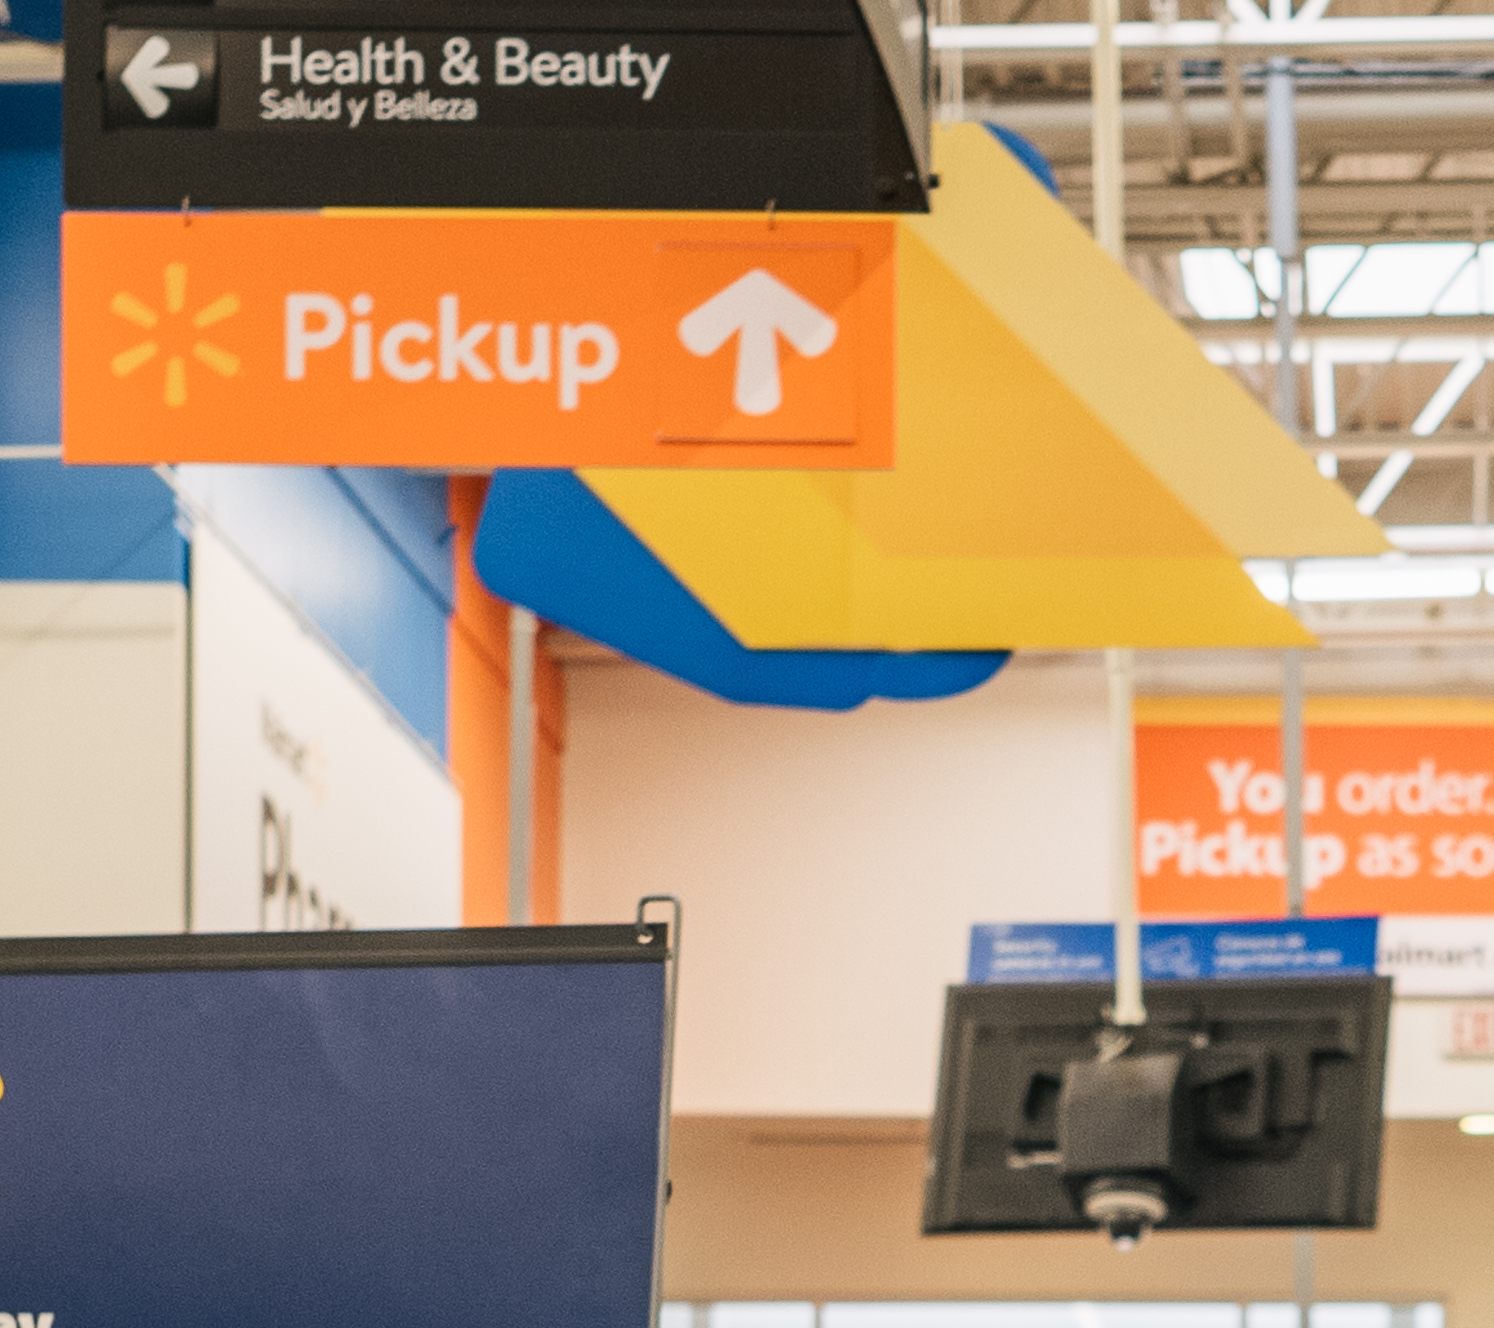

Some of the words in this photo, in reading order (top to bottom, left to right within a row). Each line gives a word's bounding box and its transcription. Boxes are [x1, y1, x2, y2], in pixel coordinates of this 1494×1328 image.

[259, 36, 424, 85] Health
[440, 38, 480, 86] &
[495, 39, 671, 98] Beauty
[259, 91, 341, 121] Salud
[348, 98, 366, 127] y
[374, 92, 478, 121] Belleza
[284, 292, 621, 412] Pickup
[1208, 756, 1322, 817] You
[1139, 820, 1344, 890] Pickup
[1357, 830, 1420, 877] as
[1375, 934, 1486, 965] almart
